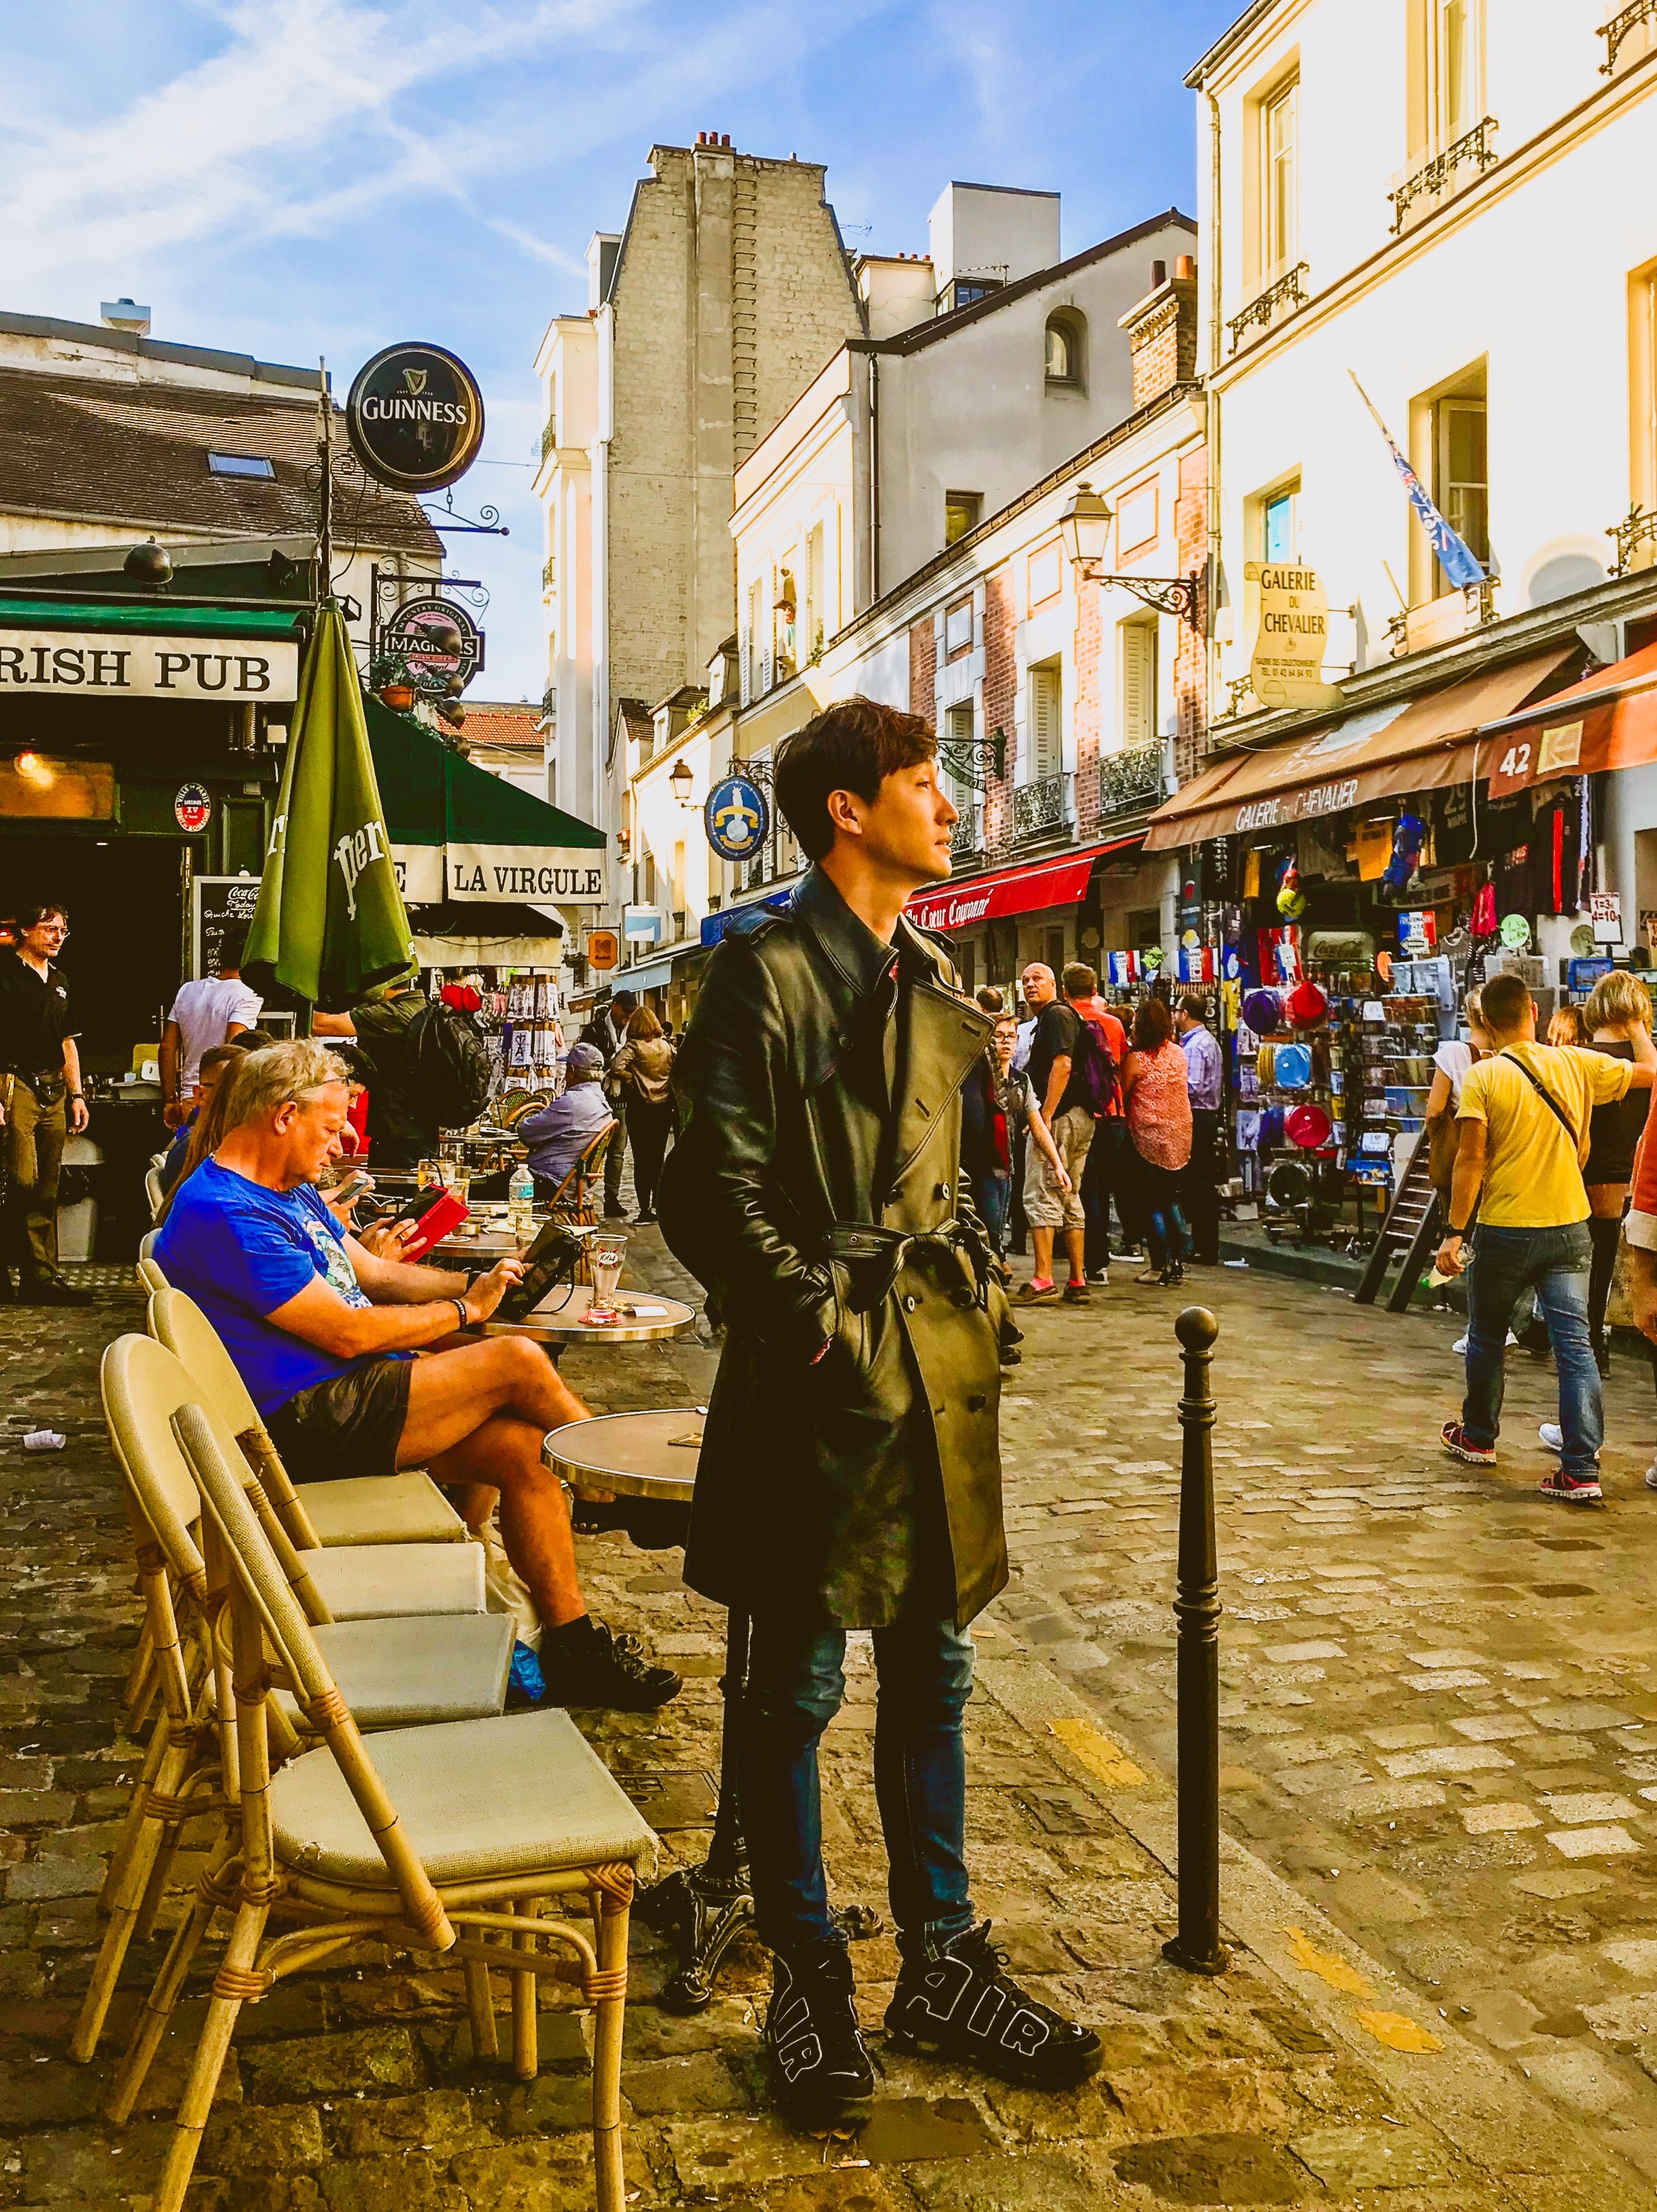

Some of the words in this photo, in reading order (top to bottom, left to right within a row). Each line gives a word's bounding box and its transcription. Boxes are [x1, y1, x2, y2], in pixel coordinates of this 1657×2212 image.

[362, 397, 467, 425] GUINNESS
[1261, 569, 1315, 591] GALERIE
[1289, 595, 1300, 608] DU
[435, 604, 467, 631] ORIGINAL
[1264, 612, 1325, 635] CHEVALIER
[391, 636, 474, 655] MAGNS
[154, 652, 270, 692] PUB
[1499, 742, 1531, 777] 42
[1235, 797, 1281, 831] GALERIE
[1294, 778, 1358, 815] CHEVALIER
[454, 864, 487, 892] LA
[493, 866, 602, 895] VIRGULE
[948, 888, 994, 925] Couronné
[906, 1955, 1050, 2056] AIR
